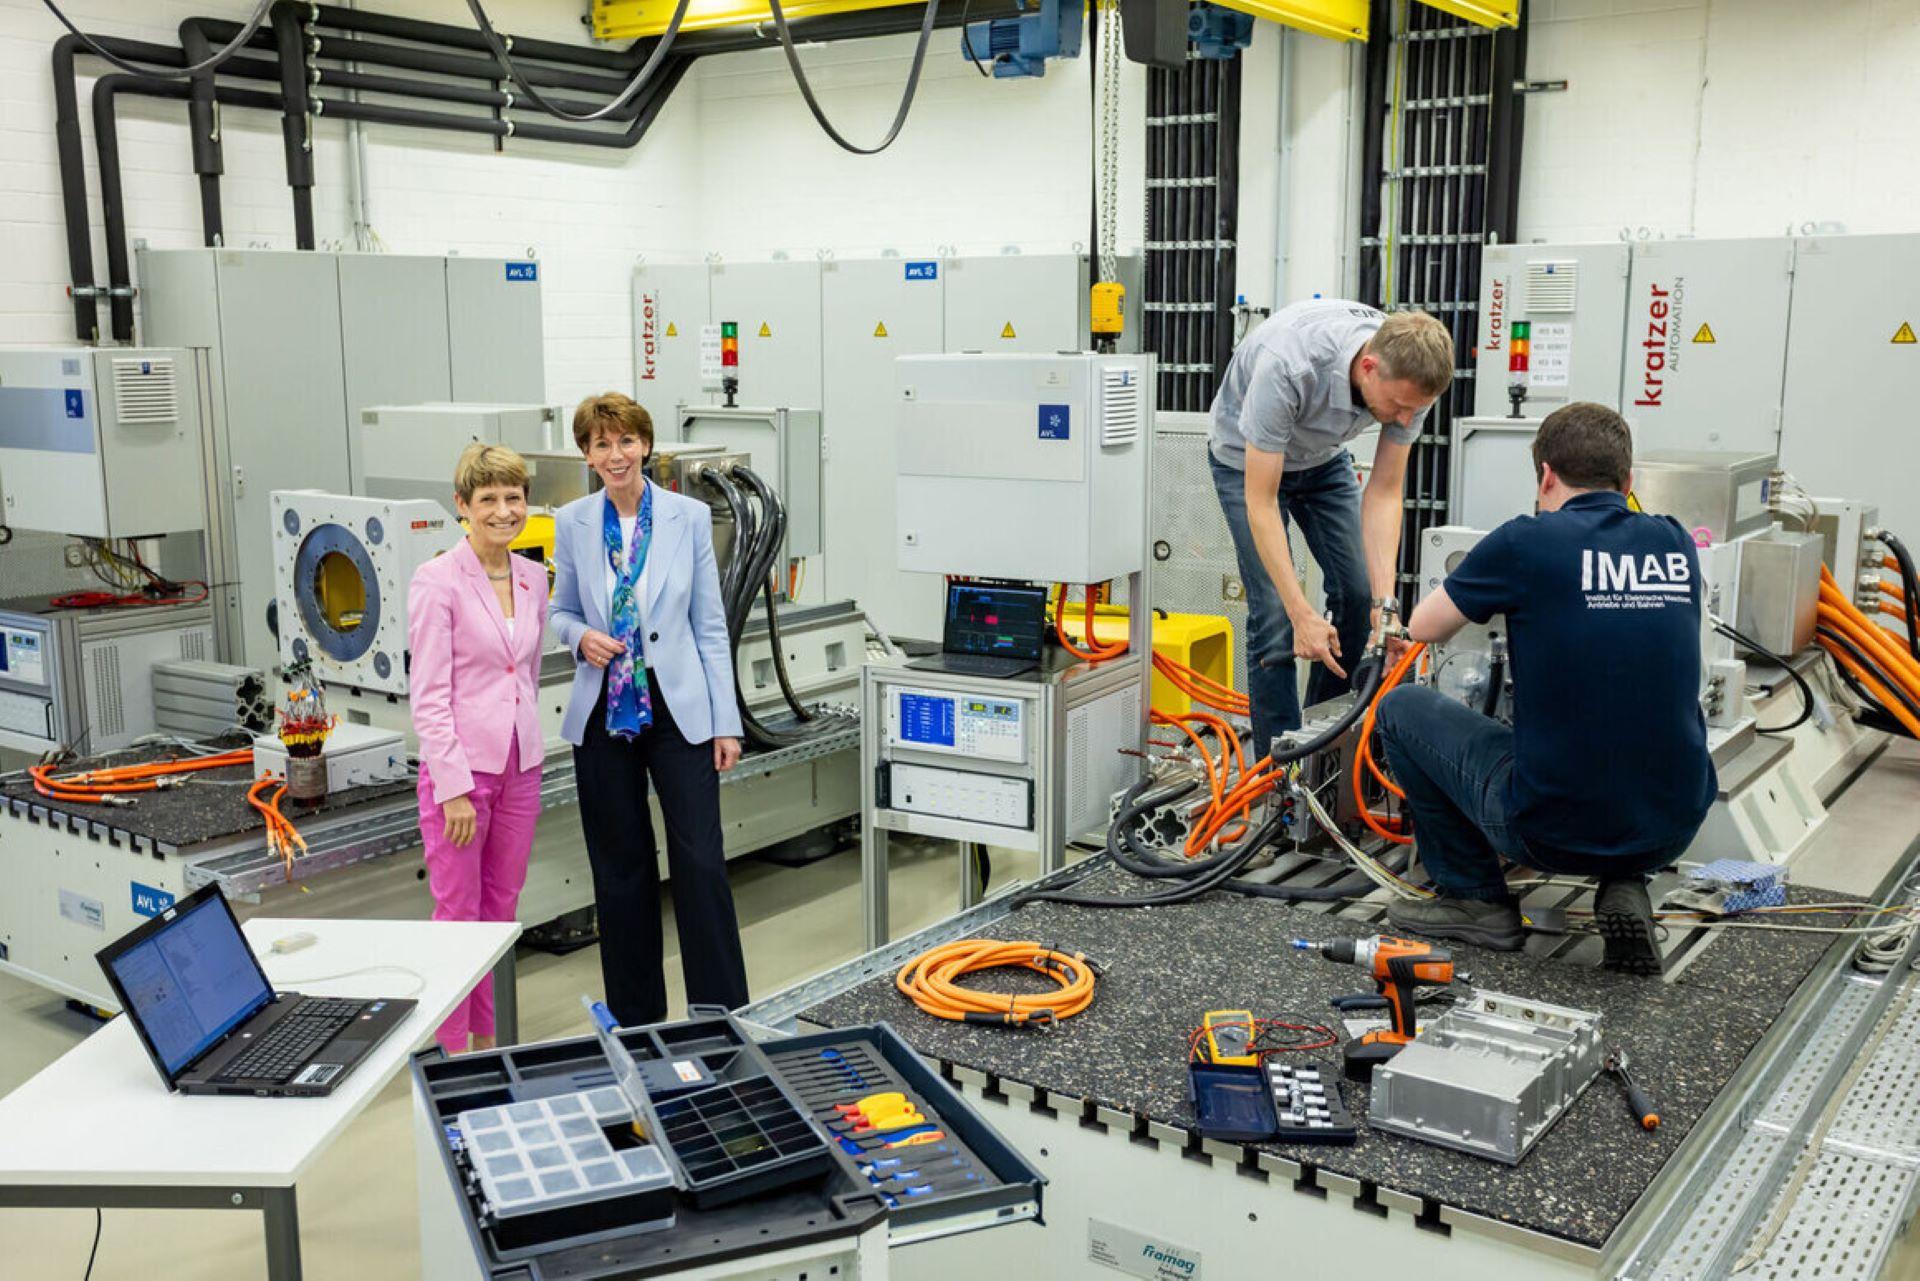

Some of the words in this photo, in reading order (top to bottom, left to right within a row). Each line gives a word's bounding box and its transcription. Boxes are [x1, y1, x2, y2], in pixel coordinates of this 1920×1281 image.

[641, 293, 655, 380] kratzer
[1485, 279, 1503, 350] kratzer
[1634, 283, 1669, 406] kratzer
[1669, 277, 1684, 371] AUTOMATION
[1040, 429, 1057, 437] AVL
[1581, 549, 1690, 592] IMAB
[136, 894, 157, 913] AVL
